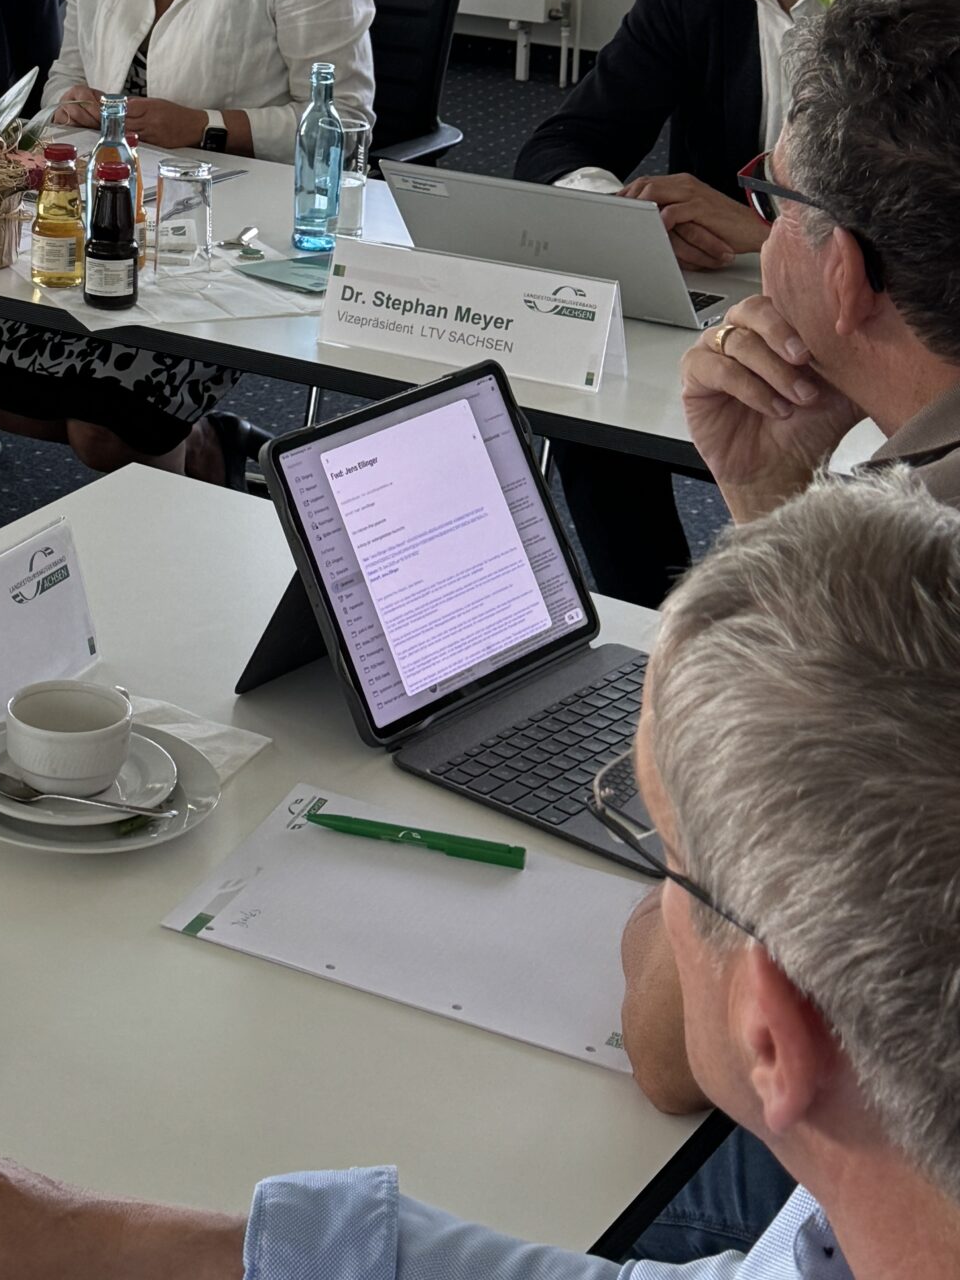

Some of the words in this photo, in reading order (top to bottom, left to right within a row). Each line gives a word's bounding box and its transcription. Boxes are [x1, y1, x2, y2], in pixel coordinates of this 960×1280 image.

[341, 285, 367, 305] Dr.
[372, 290, 448, 319] Stephan
[454, 306, 514, 332] Meyer
[337, 310, 414, 335] Vizepräsident
[420, 326, 446, 341] LTV
[448, 330, 515, 353] SACHSEN
